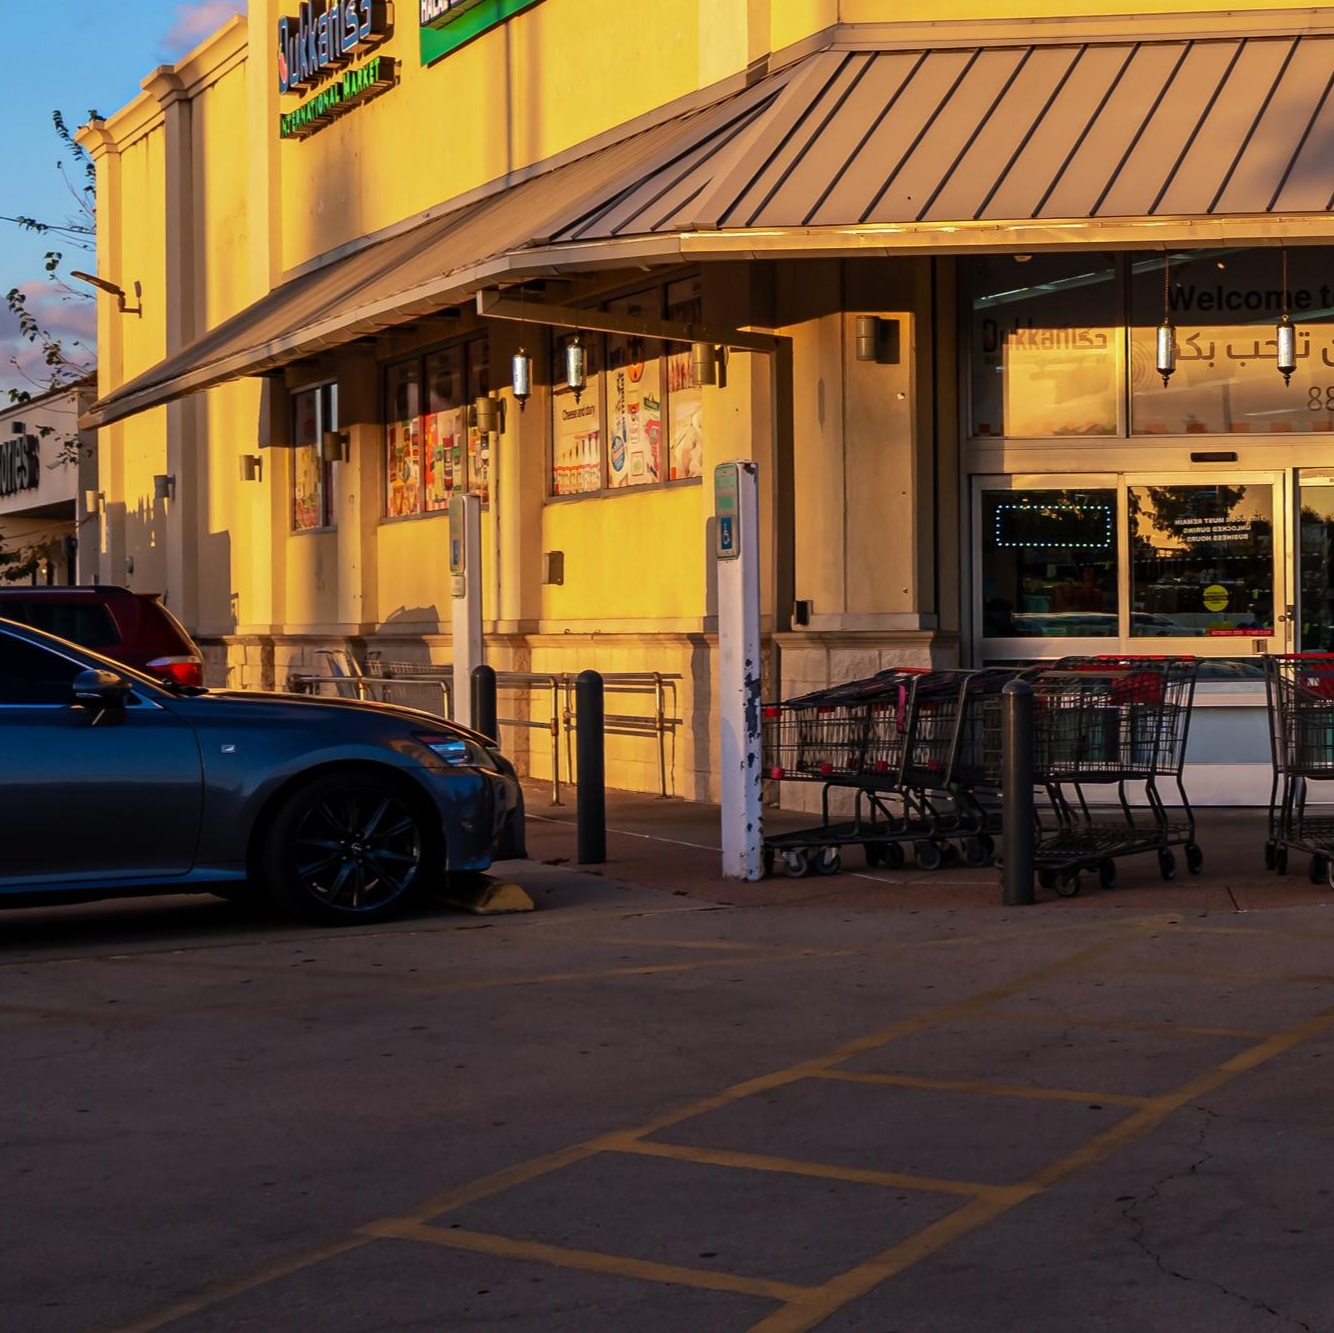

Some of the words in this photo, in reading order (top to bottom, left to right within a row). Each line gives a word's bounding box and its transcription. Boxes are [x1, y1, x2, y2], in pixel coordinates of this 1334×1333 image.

[342, 56, 381, 102] MARKET
[1168, 283, 1313, 312] Welcome
[1226, 330, 1311, 368] تحب
[563, 409, 577, 421] Cheese
